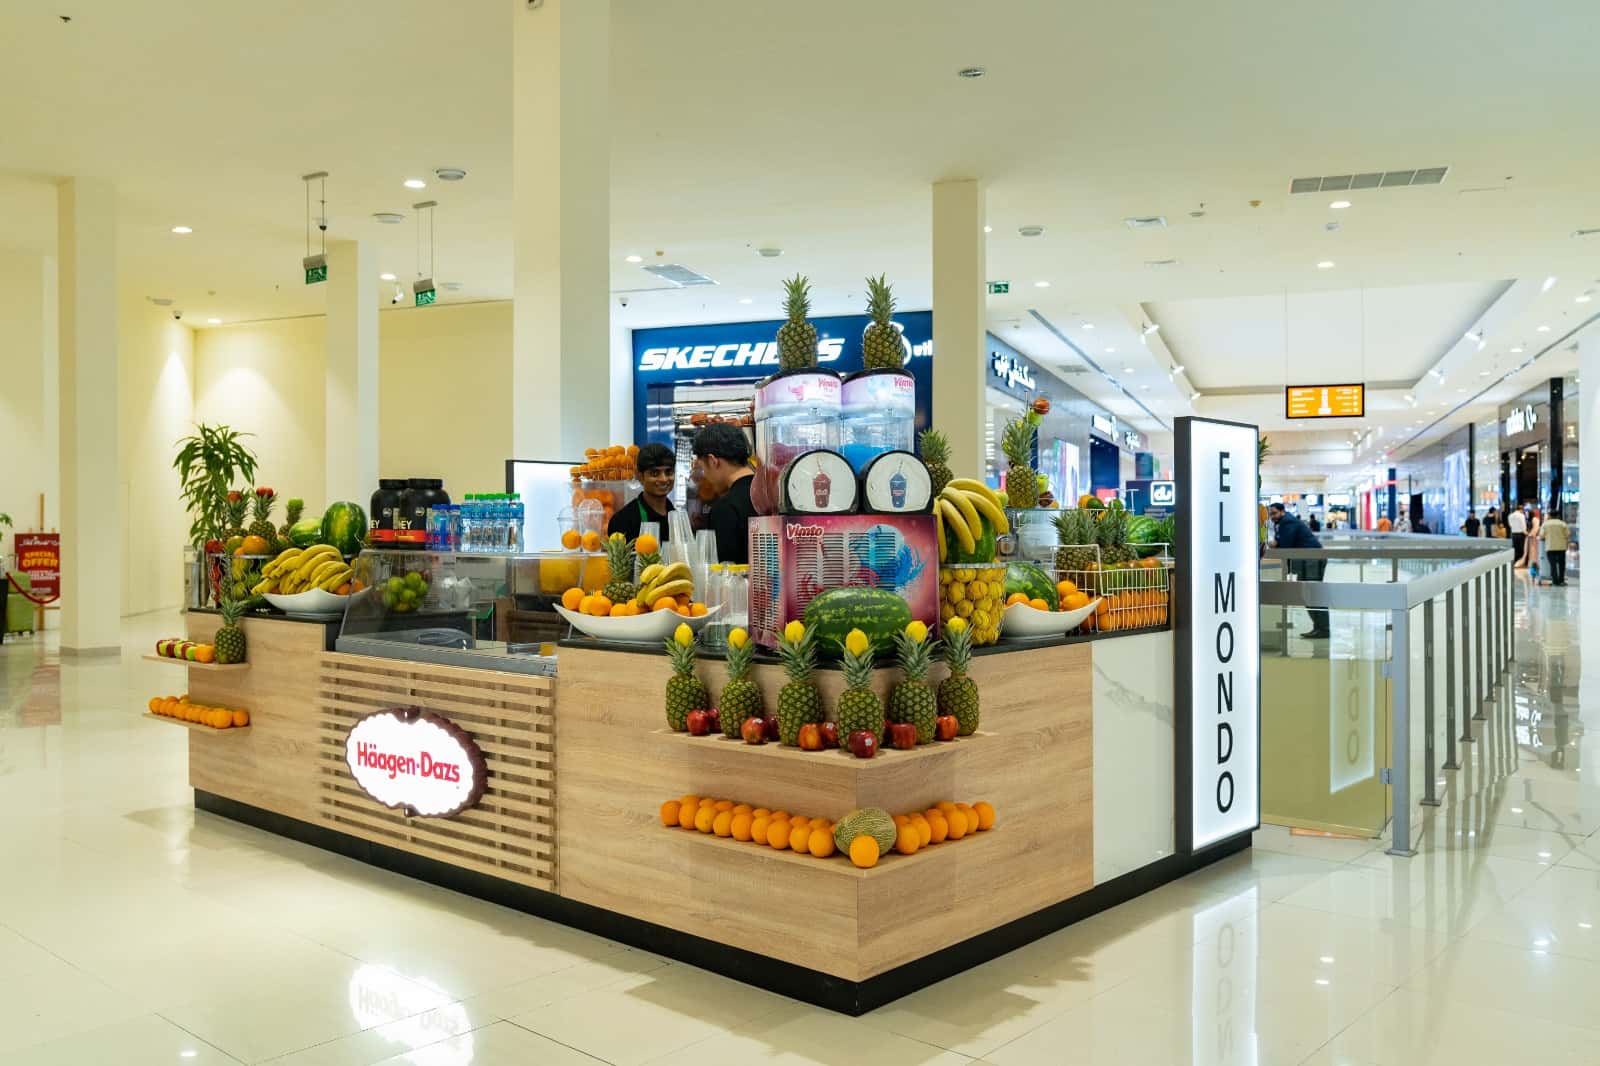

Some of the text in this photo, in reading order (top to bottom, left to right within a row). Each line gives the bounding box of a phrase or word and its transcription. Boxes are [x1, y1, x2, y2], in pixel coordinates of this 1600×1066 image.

[639, 338, 845, 371] SKECHES
[786, 523, 824, 539] Vimto
[22, 558, 58, 567] OFFER
[1215, 572, 1235, 813] MONDO
